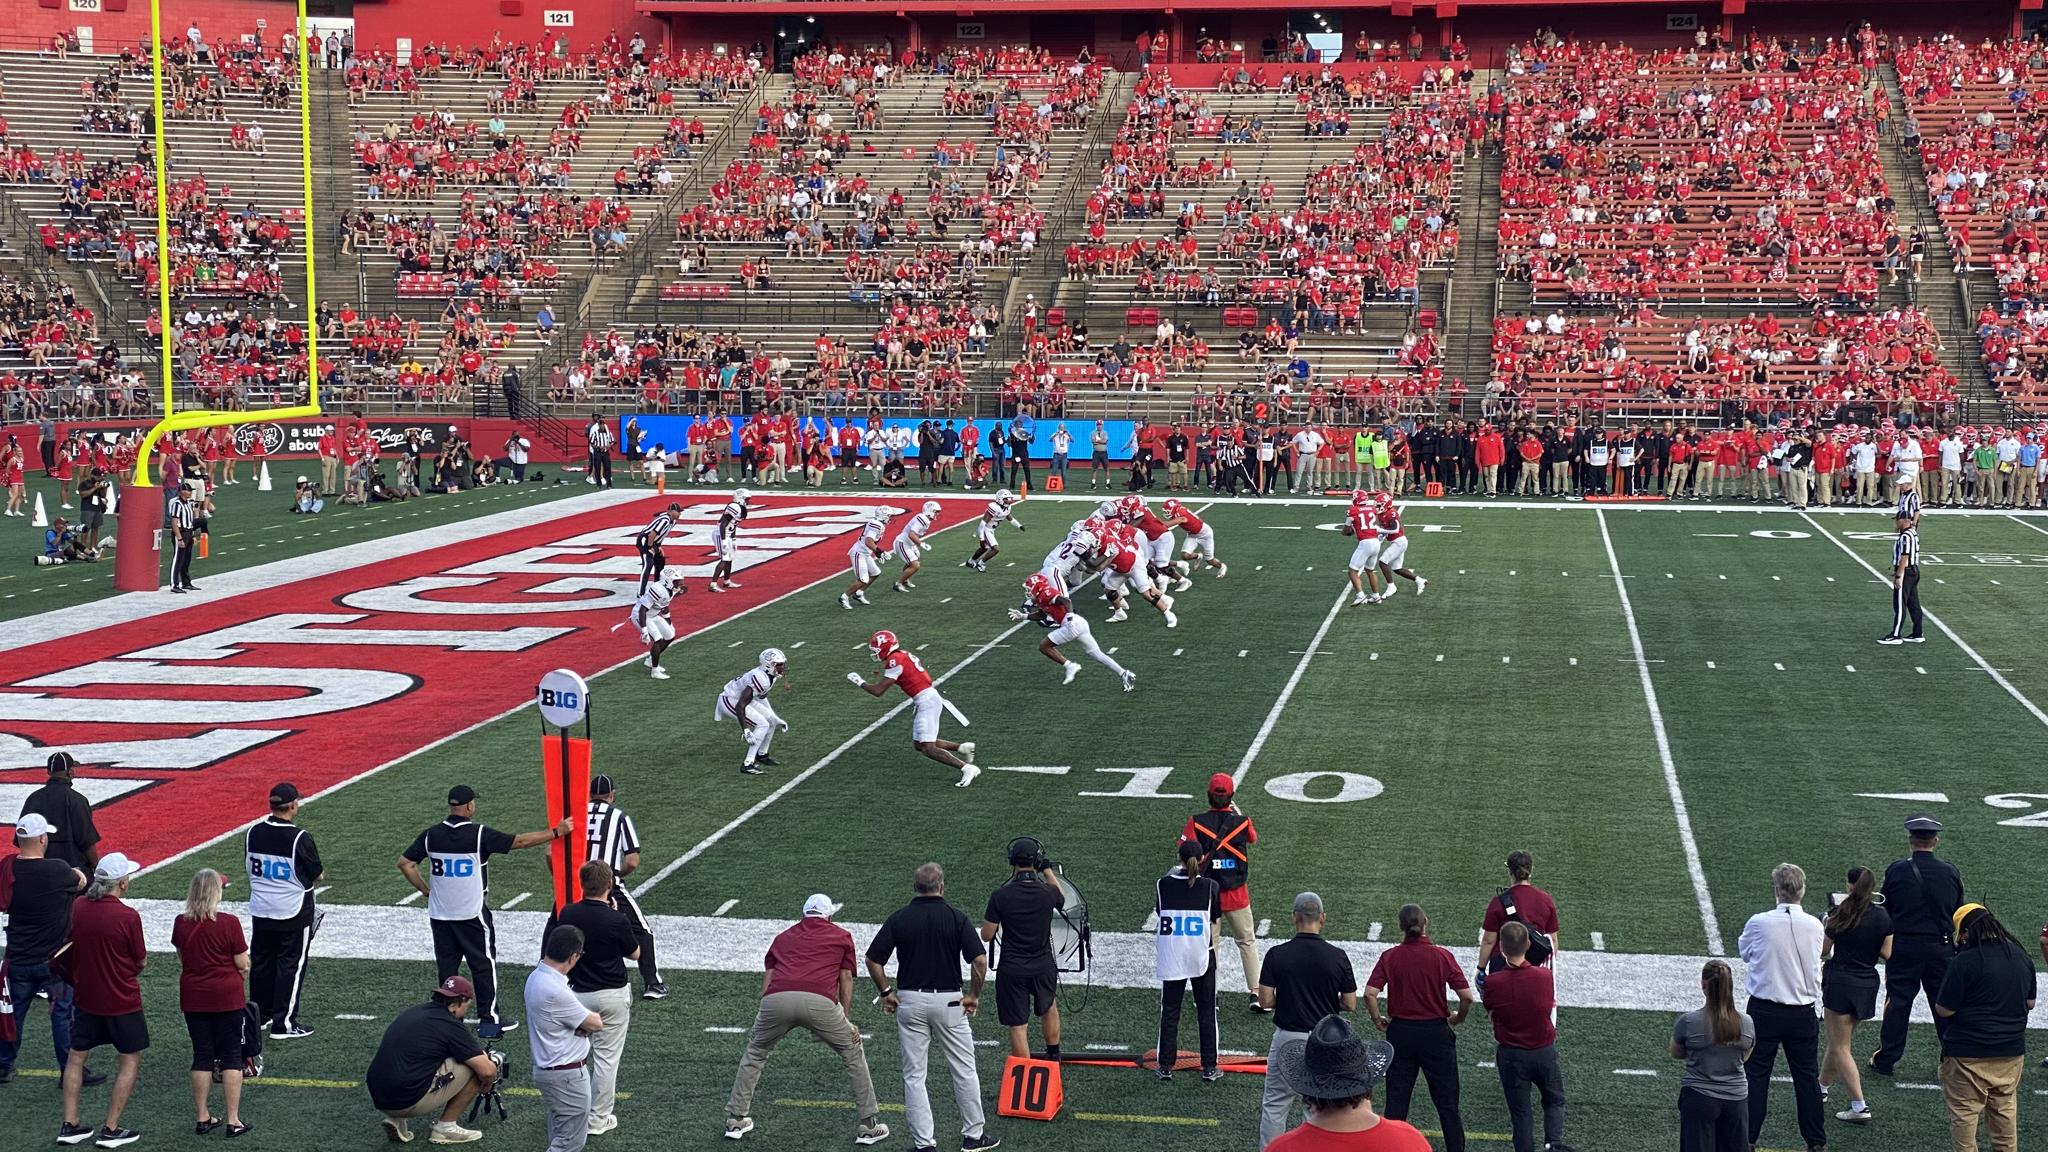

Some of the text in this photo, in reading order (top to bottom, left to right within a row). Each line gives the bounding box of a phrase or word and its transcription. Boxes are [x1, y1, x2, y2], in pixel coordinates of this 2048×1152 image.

[75, 0, 97, 9] 120
[550, 13, 570, 23] 121
[1670, 17, 1694, 27] 124
[960, 26, 981, 35] 122
[1255, 403, 1267, 418] 2
[291, 425, 326, 437] a sub
[370, 427, 433, 447] Shopte
[289, 439, 320, 451] abov
[1049, 478, 1058, 489] G
[1429, 484, 1439, 494] 10
[1358, 512, 1377, 530] 12
[1031, 575, 1039, 584] R
[876, 634, 888, 647] R
[889, 659, 897, 668] 8
[1011, 1064, 1050, 1113] 10
